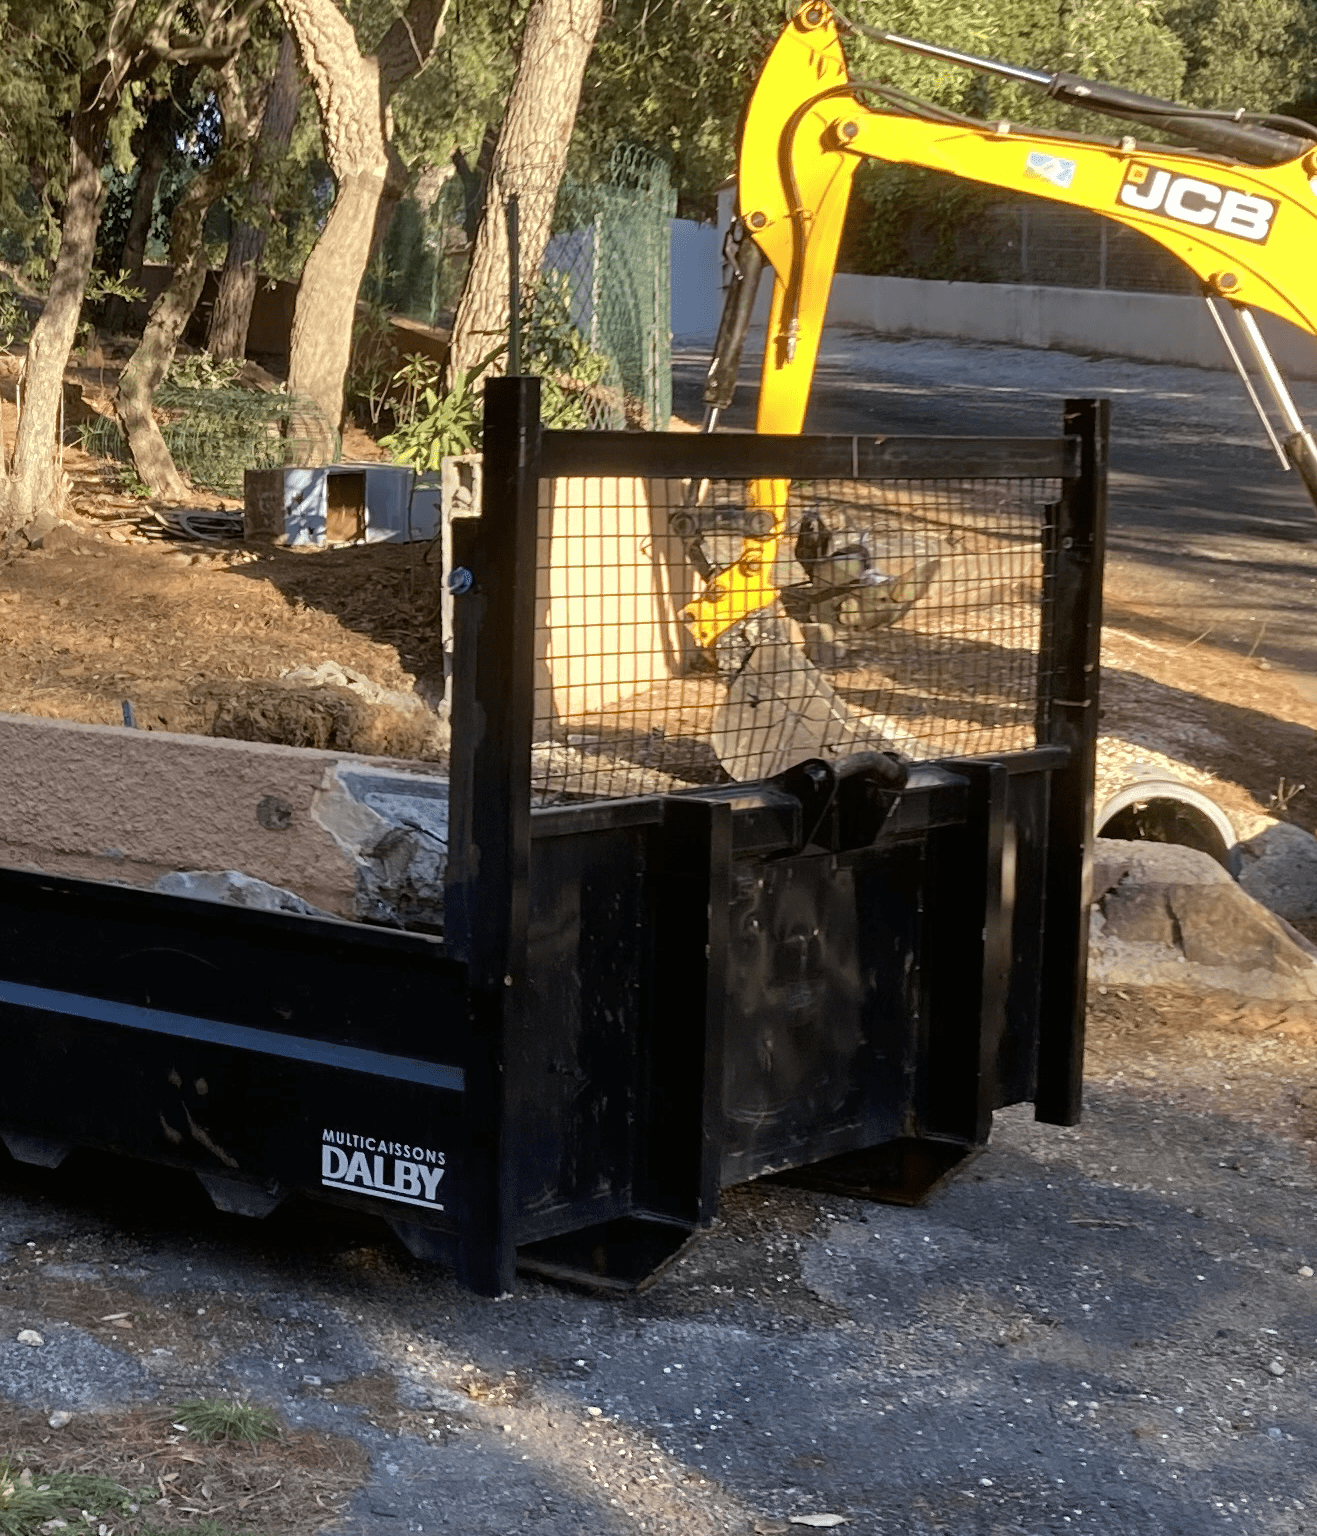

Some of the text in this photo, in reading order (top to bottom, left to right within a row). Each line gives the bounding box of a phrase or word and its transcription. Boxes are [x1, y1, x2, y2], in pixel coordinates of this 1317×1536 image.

[1121, 170, 1274, 240] JCB
[322, 1129, 446, 1166] MULTICAISSONS
[322, 1144, 445, 1201] DALBY
